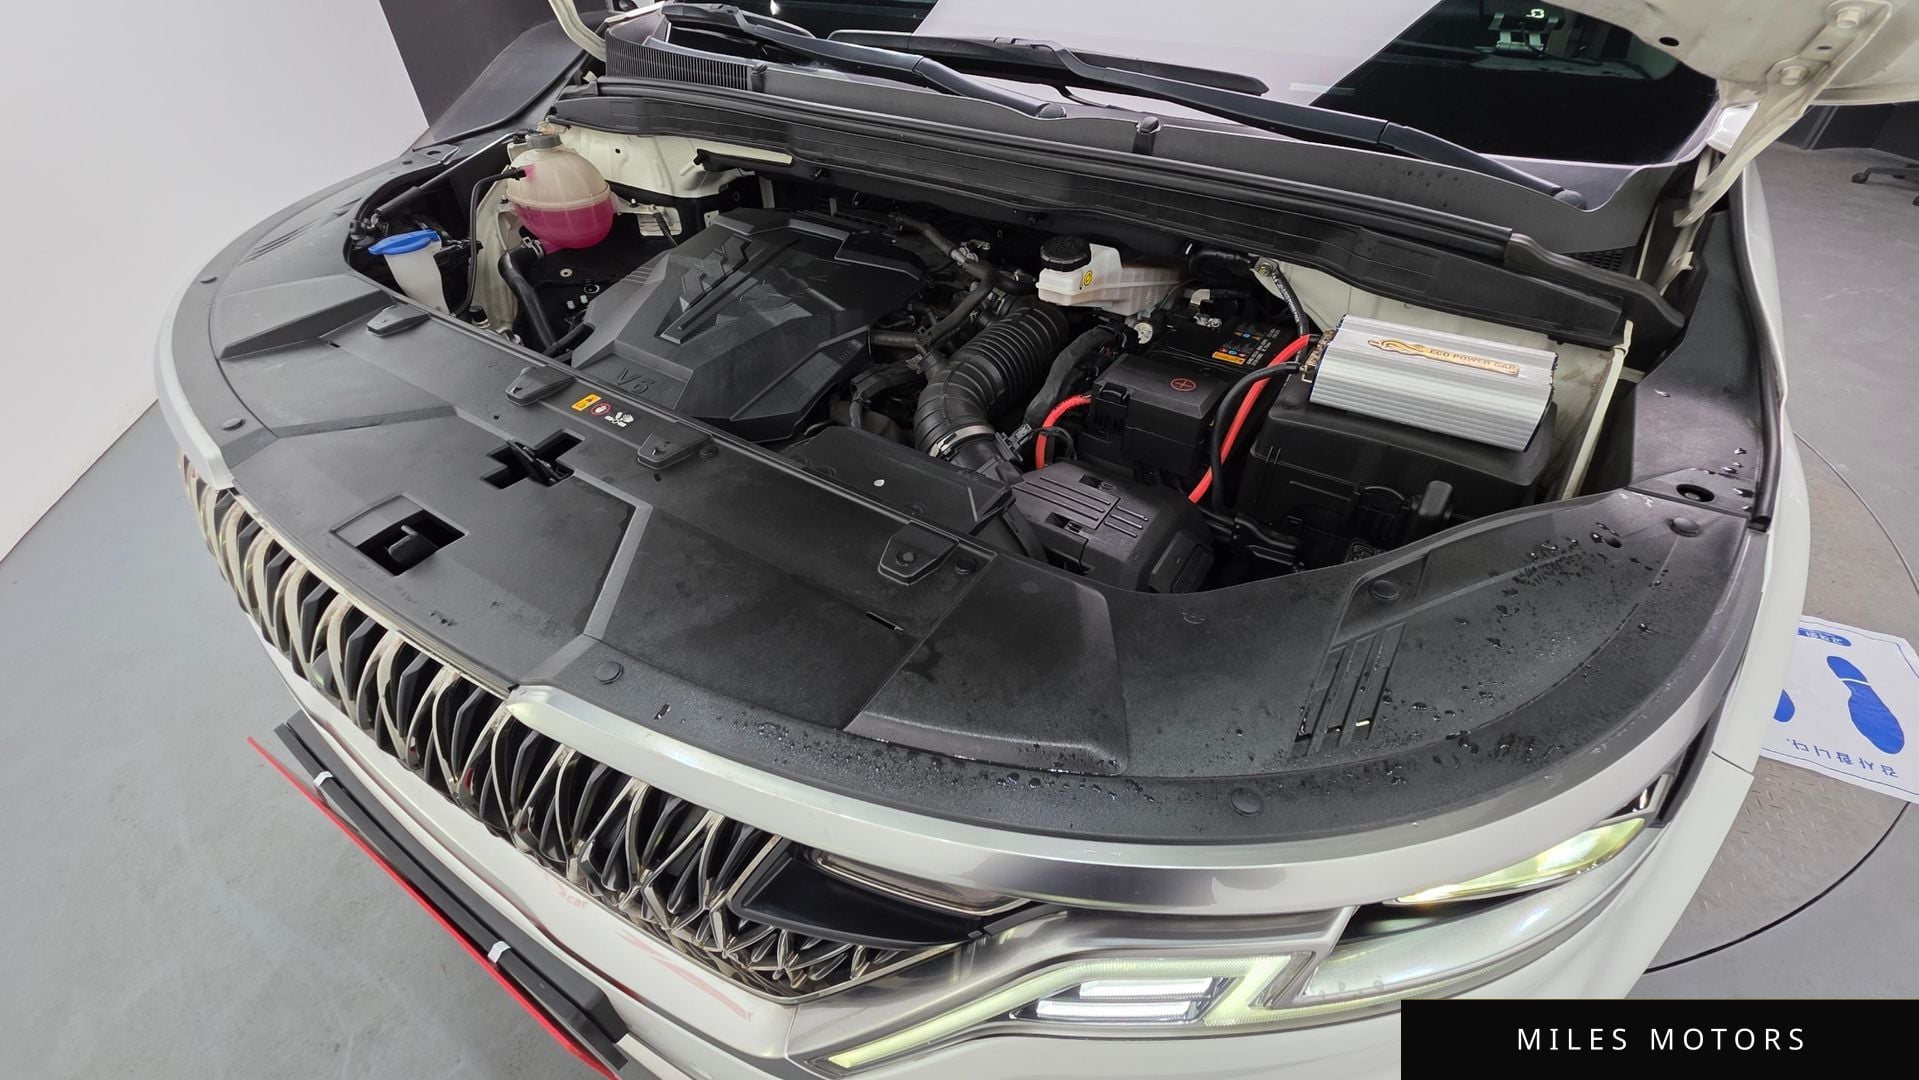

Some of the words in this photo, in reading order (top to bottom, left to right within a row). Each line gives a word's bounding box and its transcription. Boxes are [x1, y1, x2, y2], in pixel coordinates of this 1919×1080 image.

[1429, 348, 1450, 358] ECO
[1453, 353, 1492, 366] POWER
[617, 368, 656, 394] V6
[1786, 738, 1899, 778] 감사합니다.
